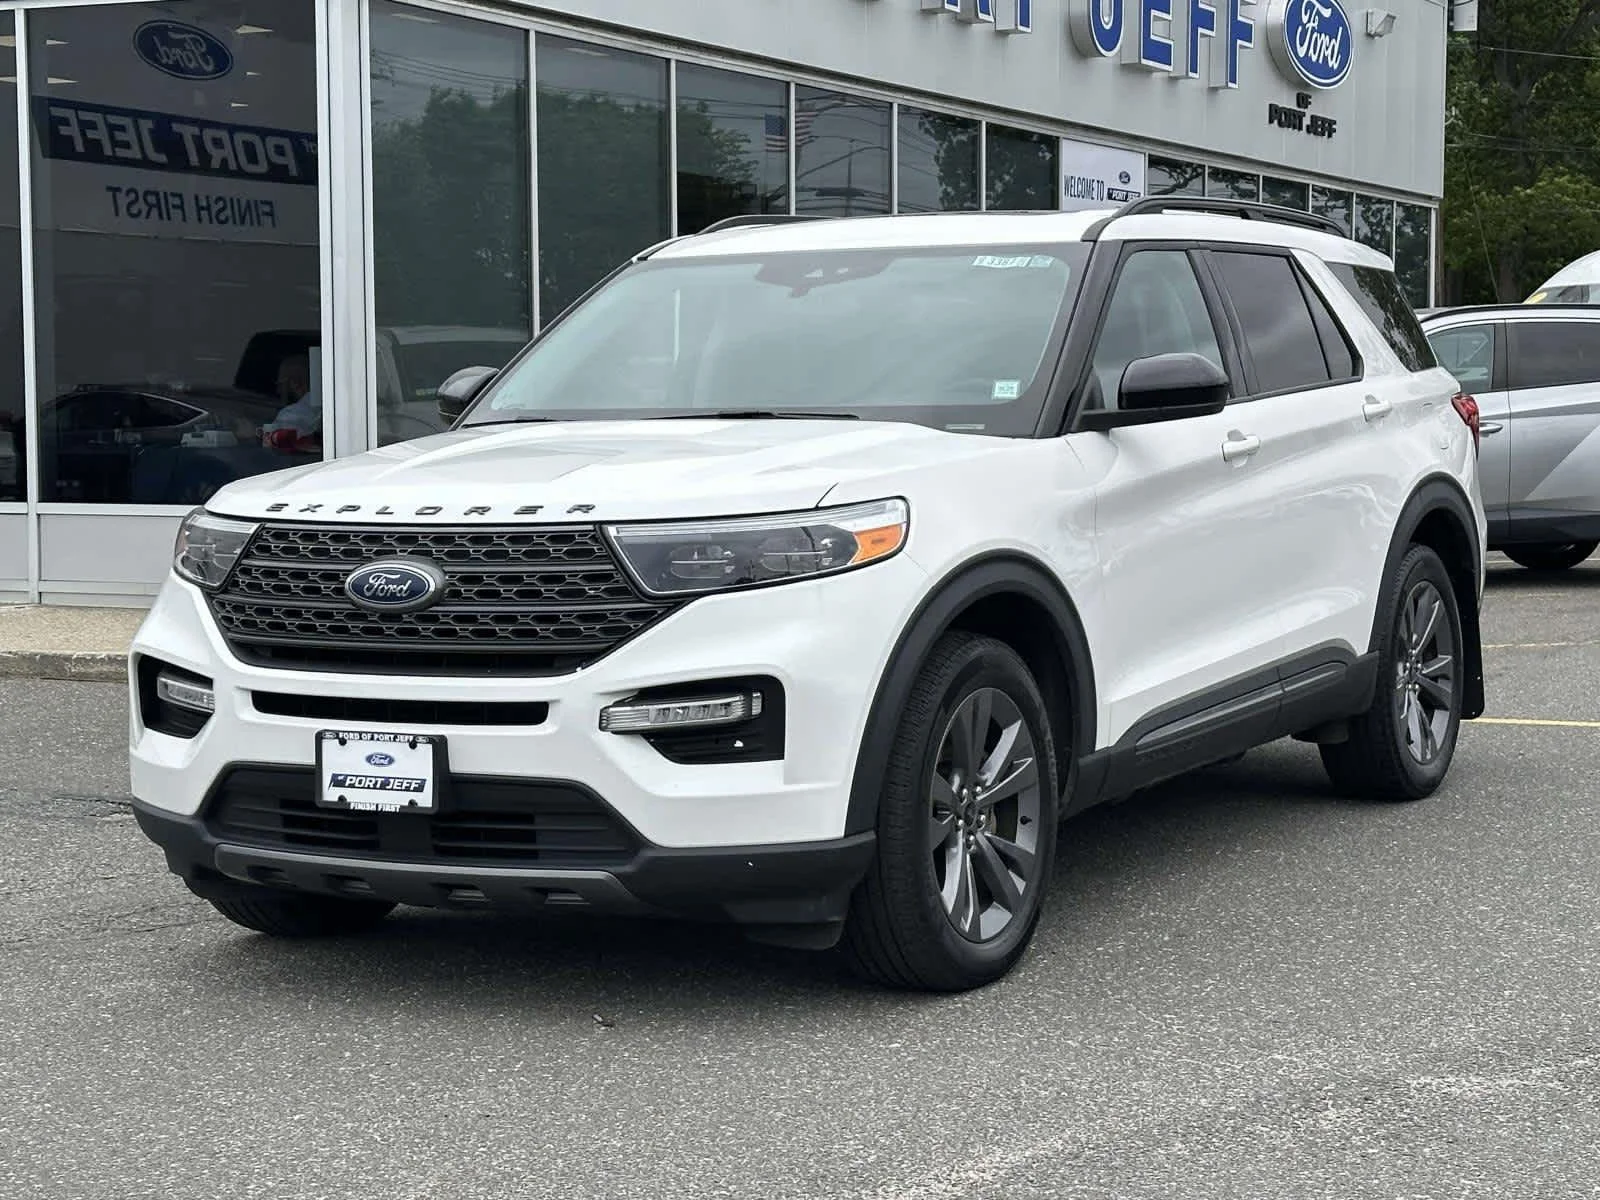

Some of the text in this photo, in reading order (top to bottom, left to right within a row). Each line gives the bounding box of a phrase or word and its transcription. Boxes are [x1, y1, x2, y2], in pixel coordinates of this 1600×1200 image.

[1296, 0, 1342, 70] Ford
[1296, 91, 1312, 109] OF
[1268, 103, 1337, 139] PORT JEFF
[1064, 175, 1095, 200] WELCOME
[1096, 180, 1105, 201] TO
[266, 503, 596, 516] EXPLORER
[363, 573, 412, 597] Ford
[339, 732, 360, 741] FORD
[361, 733, 372, 741] OF
[373, 734, 394, 742] PORT
[395, 735, 414, 743] JEFF
[370, 754, 390, 765] Ford
[345, 776, 421, 791] PORT JEFF
[350, 802, 401, 813] FINISH FIRST
